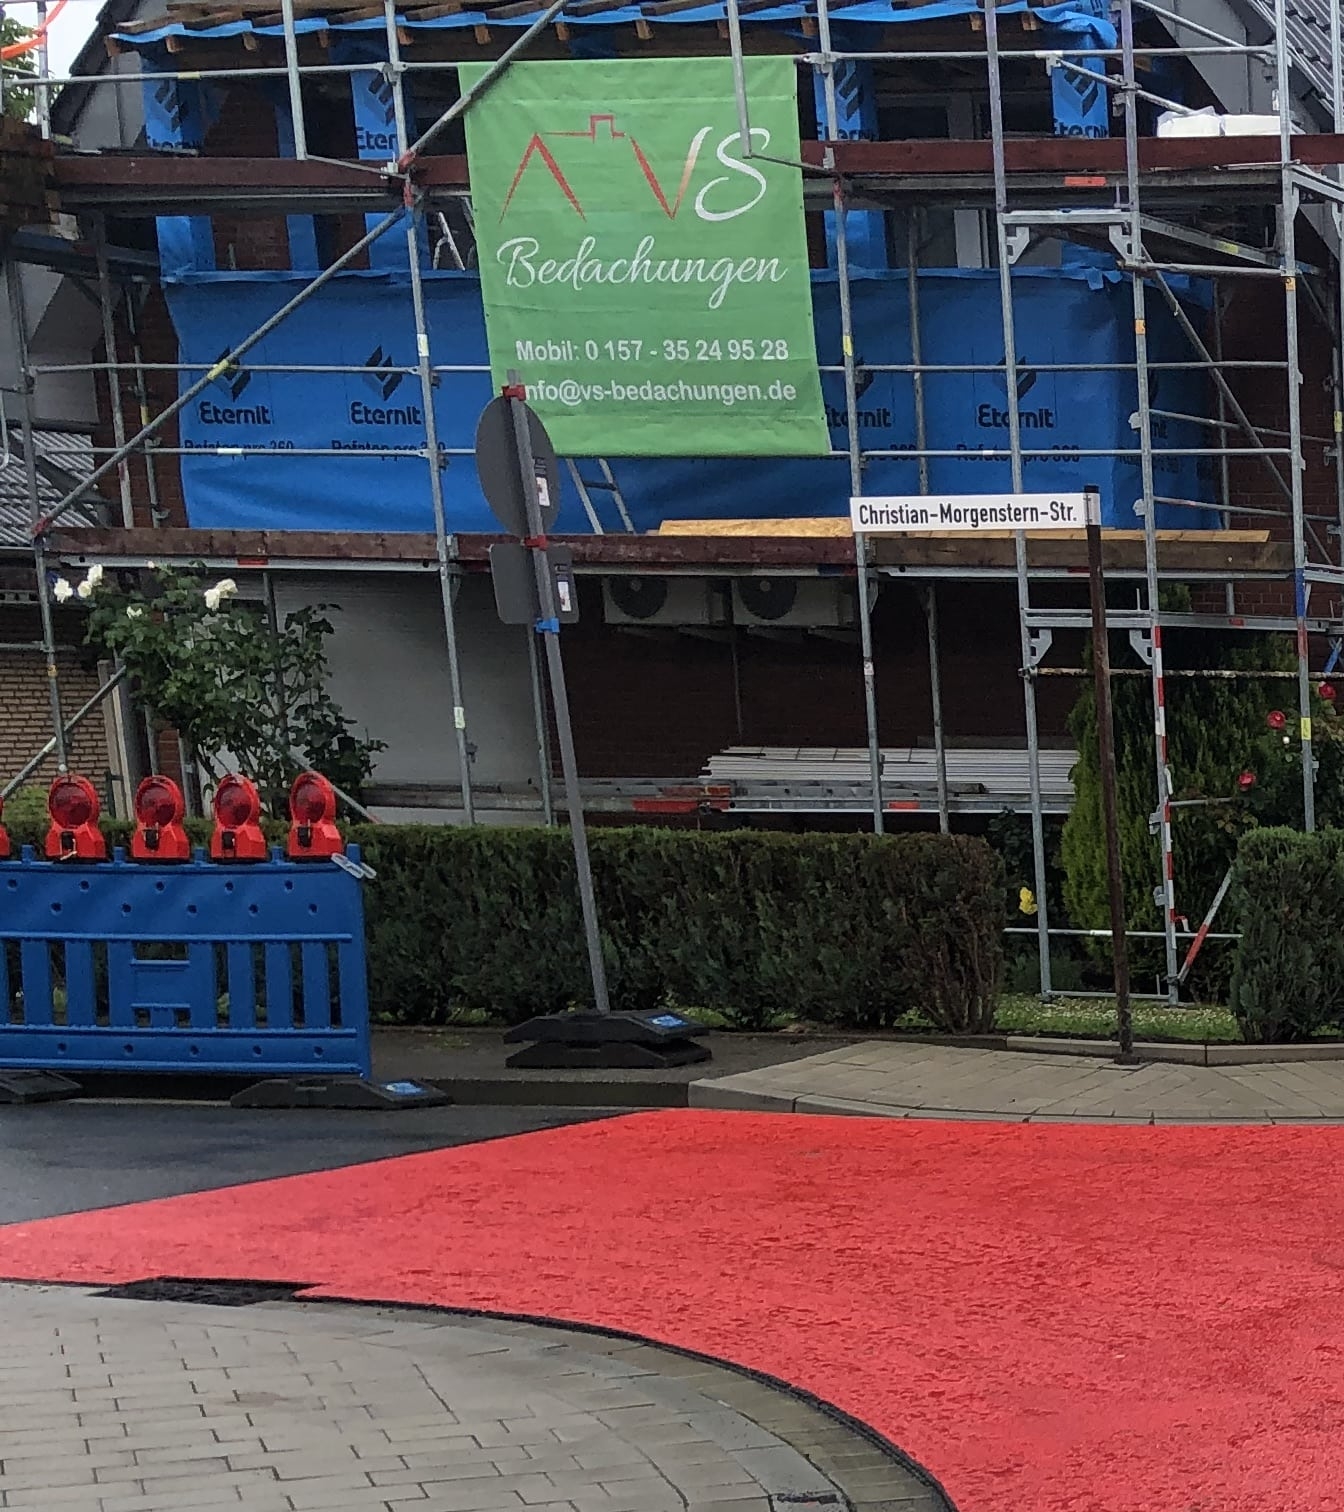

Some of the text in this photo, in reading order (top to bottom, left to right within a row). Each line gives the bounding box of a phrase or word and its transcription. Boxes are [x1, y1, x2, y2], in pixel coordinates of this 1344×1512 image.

[497, 236, 788, 309] Bedachungen
[515, 340, 580, 361] Mobil:
[586, 340, 598, 360] 0
[605, 340, 643, 361] 157
[663, 340, 690, 361] 35
[696, 339, 722, 361] 24
[729, 339, 755, 361] 95
[761, 339, 789, 361] 28
[523, 379, 797, 406] nfo@vs-bedachungen.de
[200, 402, 272, 425] Eternit
[350, 402, 422, 425] Eternit
[859, 501, 1077, 528] Christian-Morgenstern-Str.
